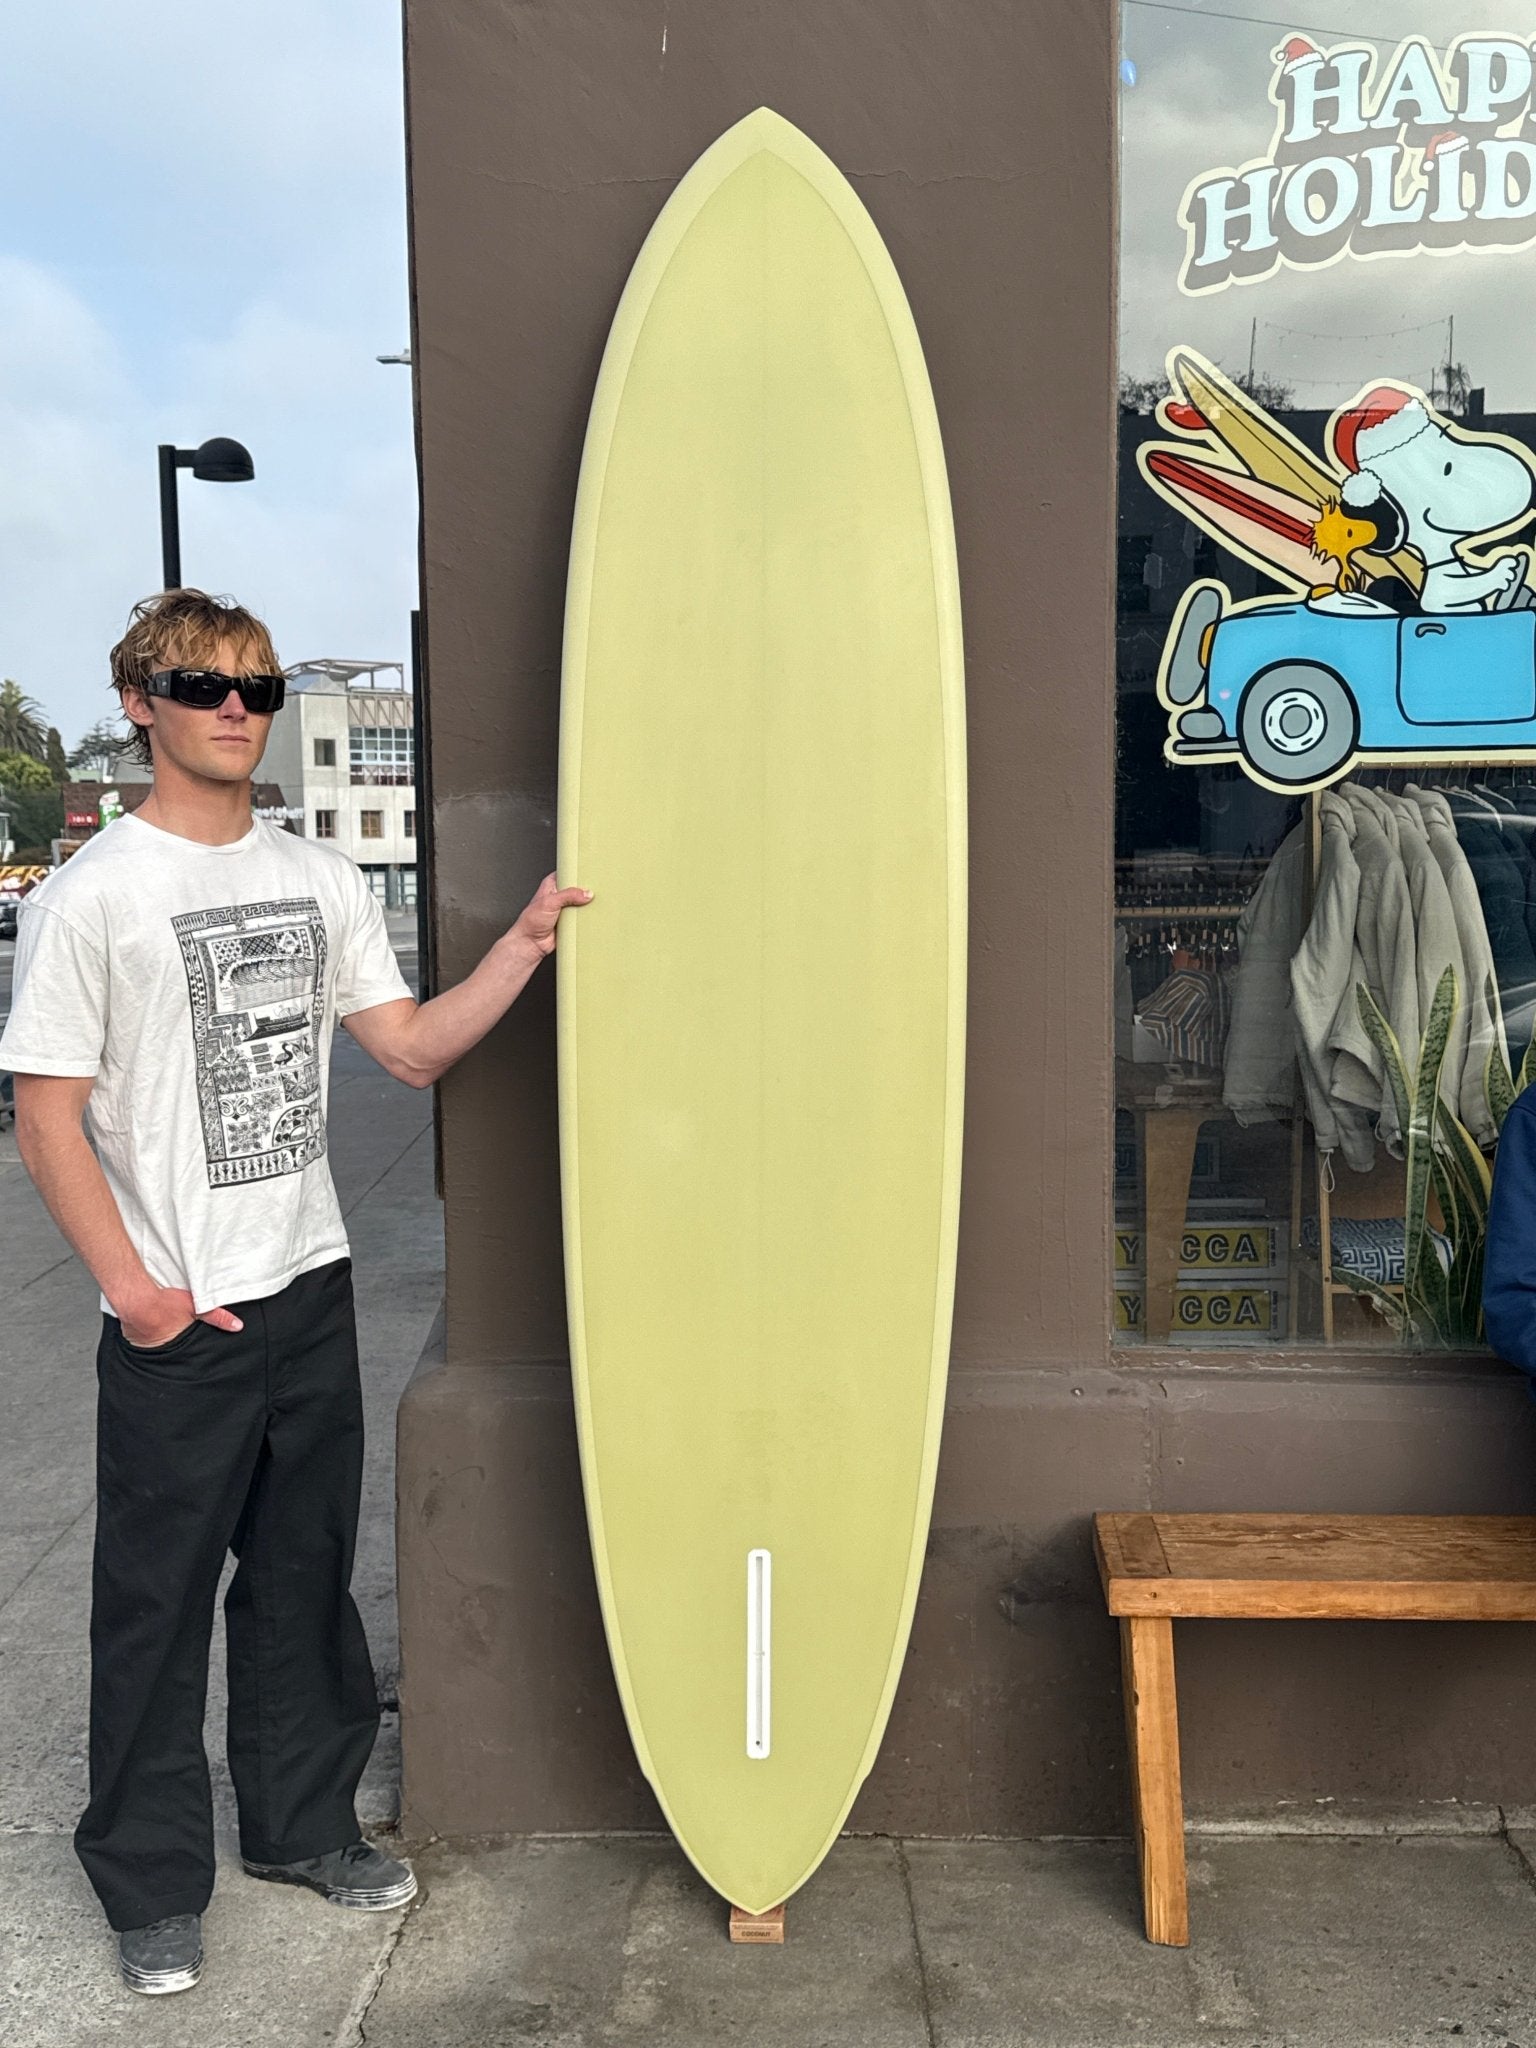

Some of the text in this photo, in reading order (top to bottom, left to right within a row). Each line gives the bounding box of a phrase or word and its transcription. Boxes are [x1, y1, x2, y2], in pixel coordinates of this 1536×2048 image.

[1280, 38, 1536, 146] HAP
[1191, 138, 1536, 268] HOLID
[1117, 1233, 1259, 1264] YCCA
[1118, 1295, 1261, 1325] YCCA
